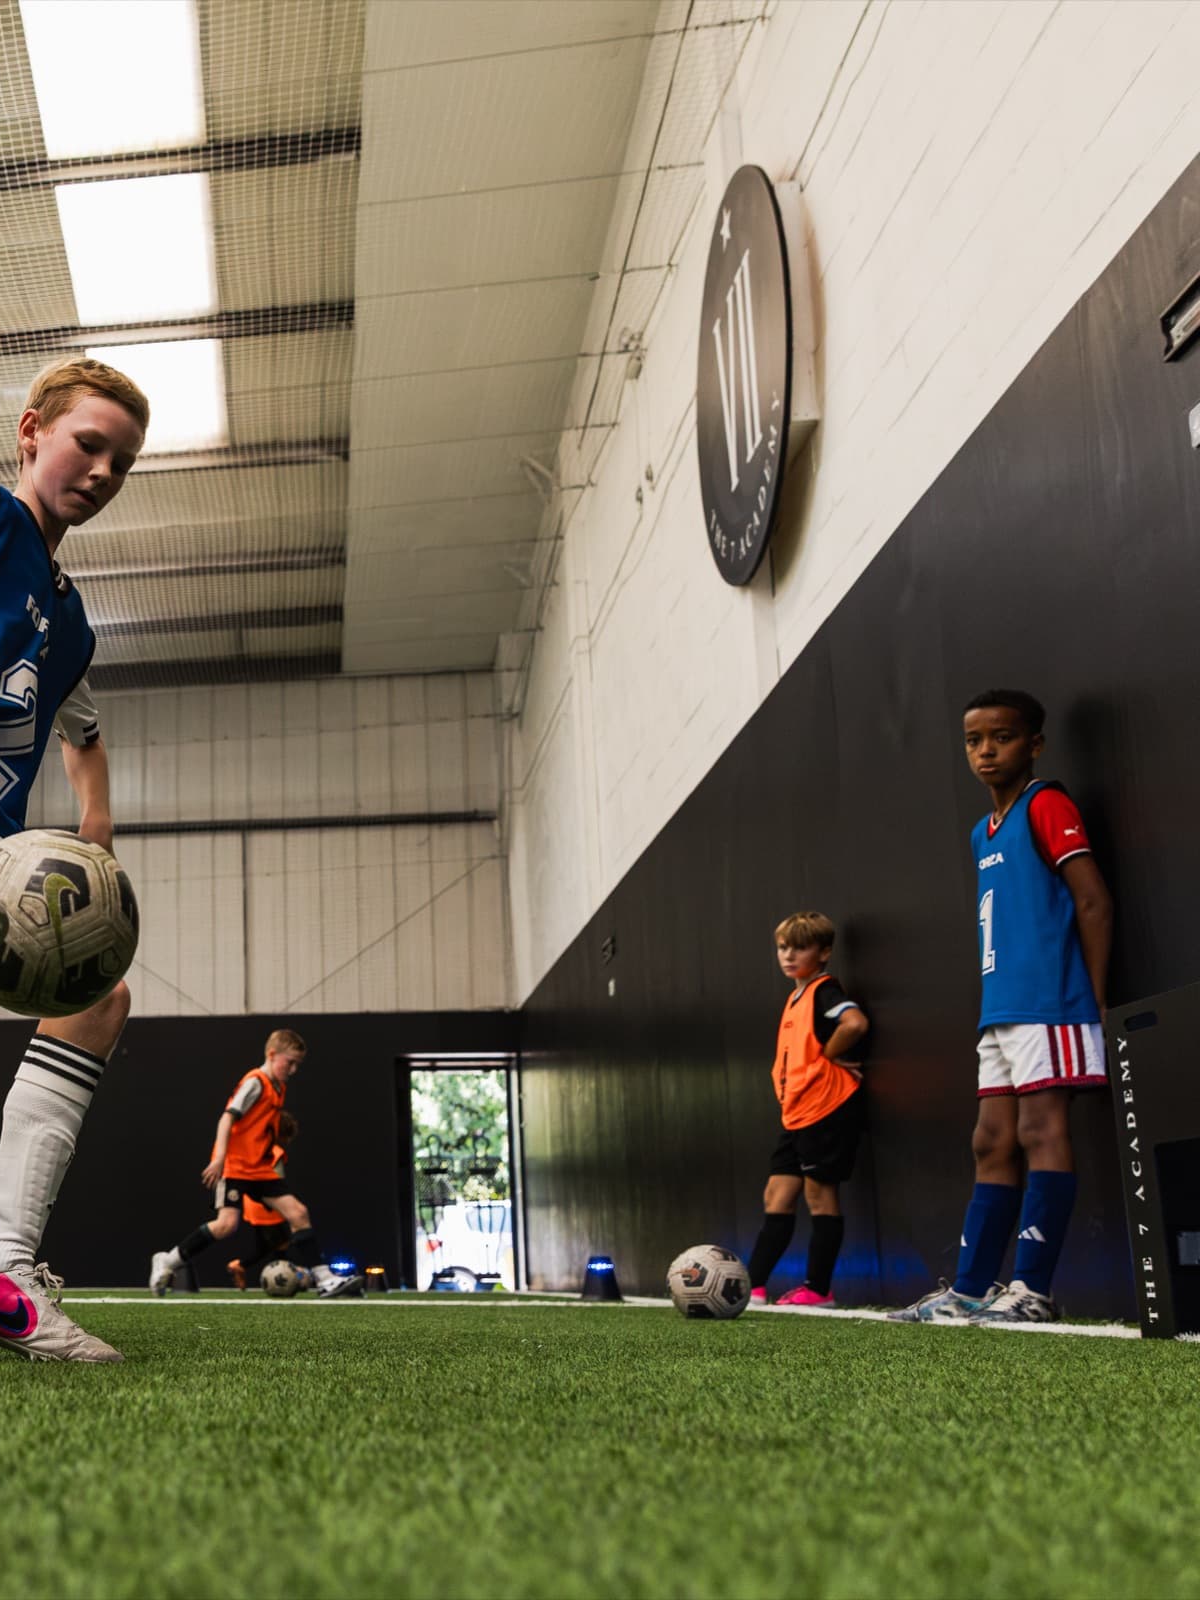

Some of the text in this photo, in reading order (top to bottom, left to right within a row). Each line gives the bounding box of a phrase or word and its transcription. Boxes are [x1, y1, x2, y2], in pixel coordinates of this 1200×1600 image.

[713, 248, 763, 493] VII
[710, 508, 727, 558] THE
[738, 391, 781, 560] ACADEMY
[979, 888, 996, 976] 1
[1116, 1037, 1159, 1324] THE 7 ACADEMY
